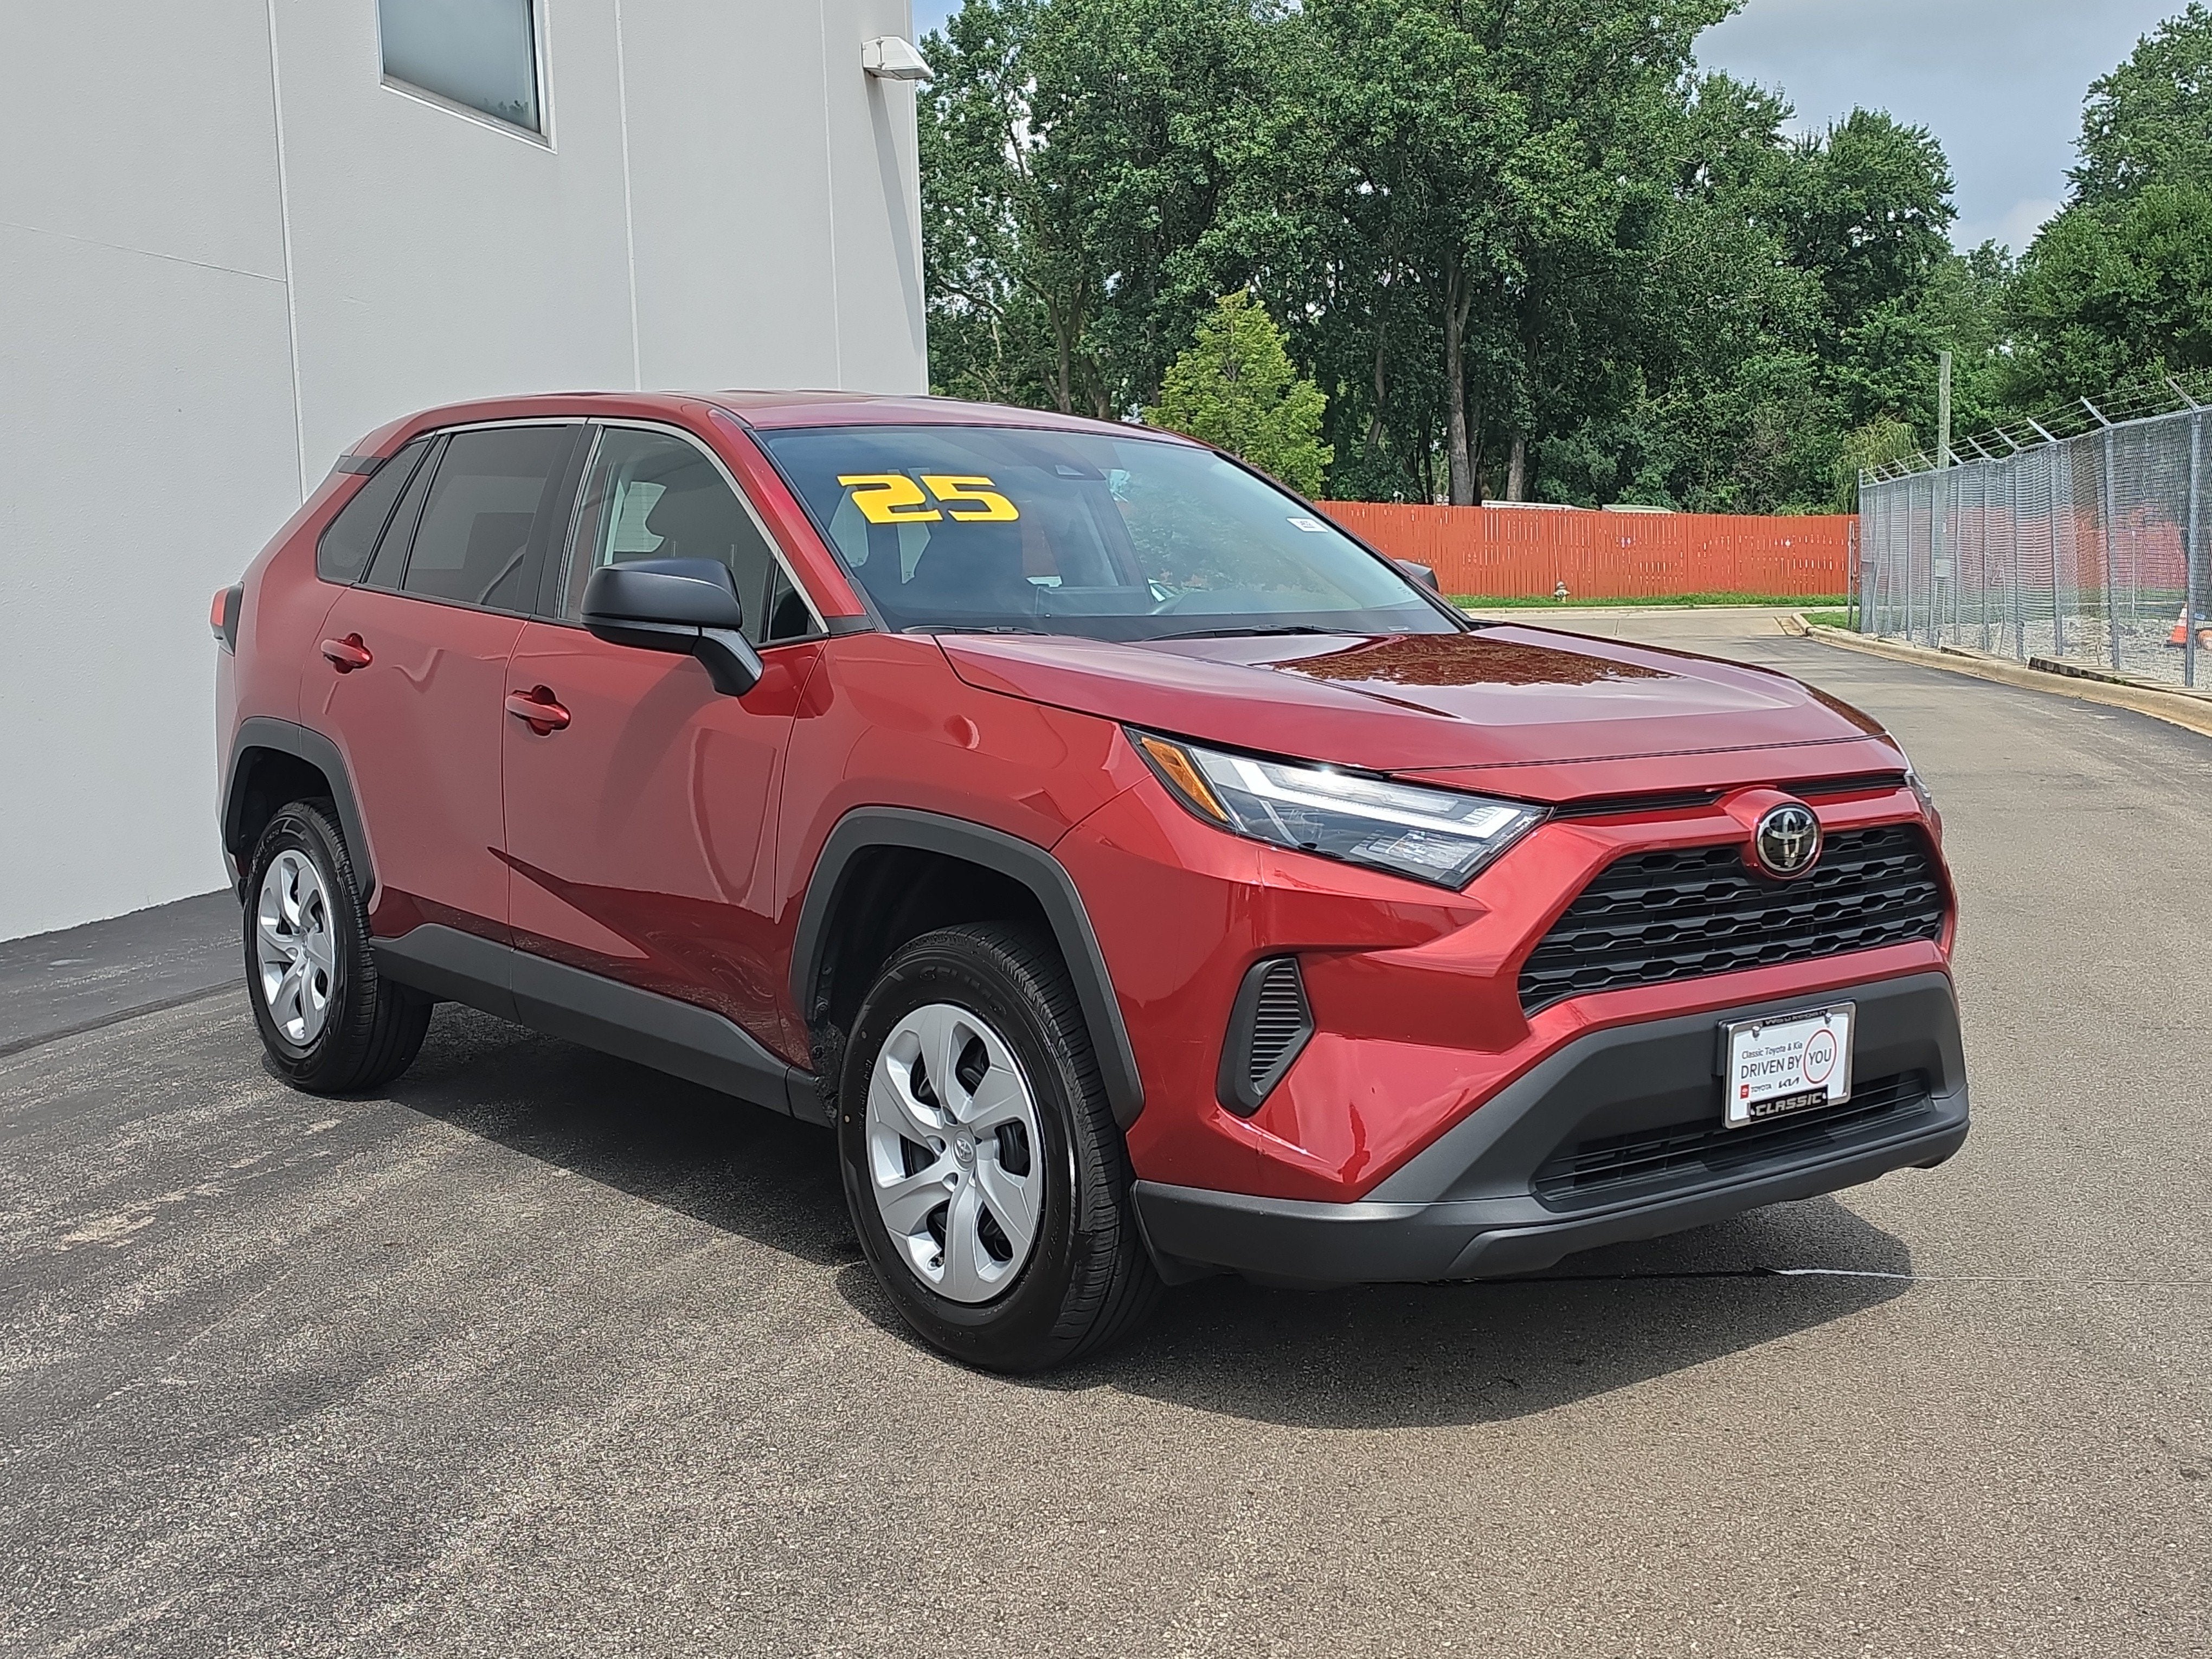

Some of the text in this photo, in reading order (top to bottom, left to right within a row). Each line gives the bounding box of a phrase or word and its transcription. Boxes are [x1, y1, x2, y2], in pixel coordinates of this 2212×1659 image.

[837, 475, 1019, 524] 25
[1741, 1049, 1764, 1059] Classic
[1765, 1045, 1786, 1056] Toyota
[1741, 1048, 1832, 1079] DRIVEN BY YOU
[1751, 1084, 1772, 1092] TOYOTA
[1756, 1092, 1823, 1116] CLASSIC
